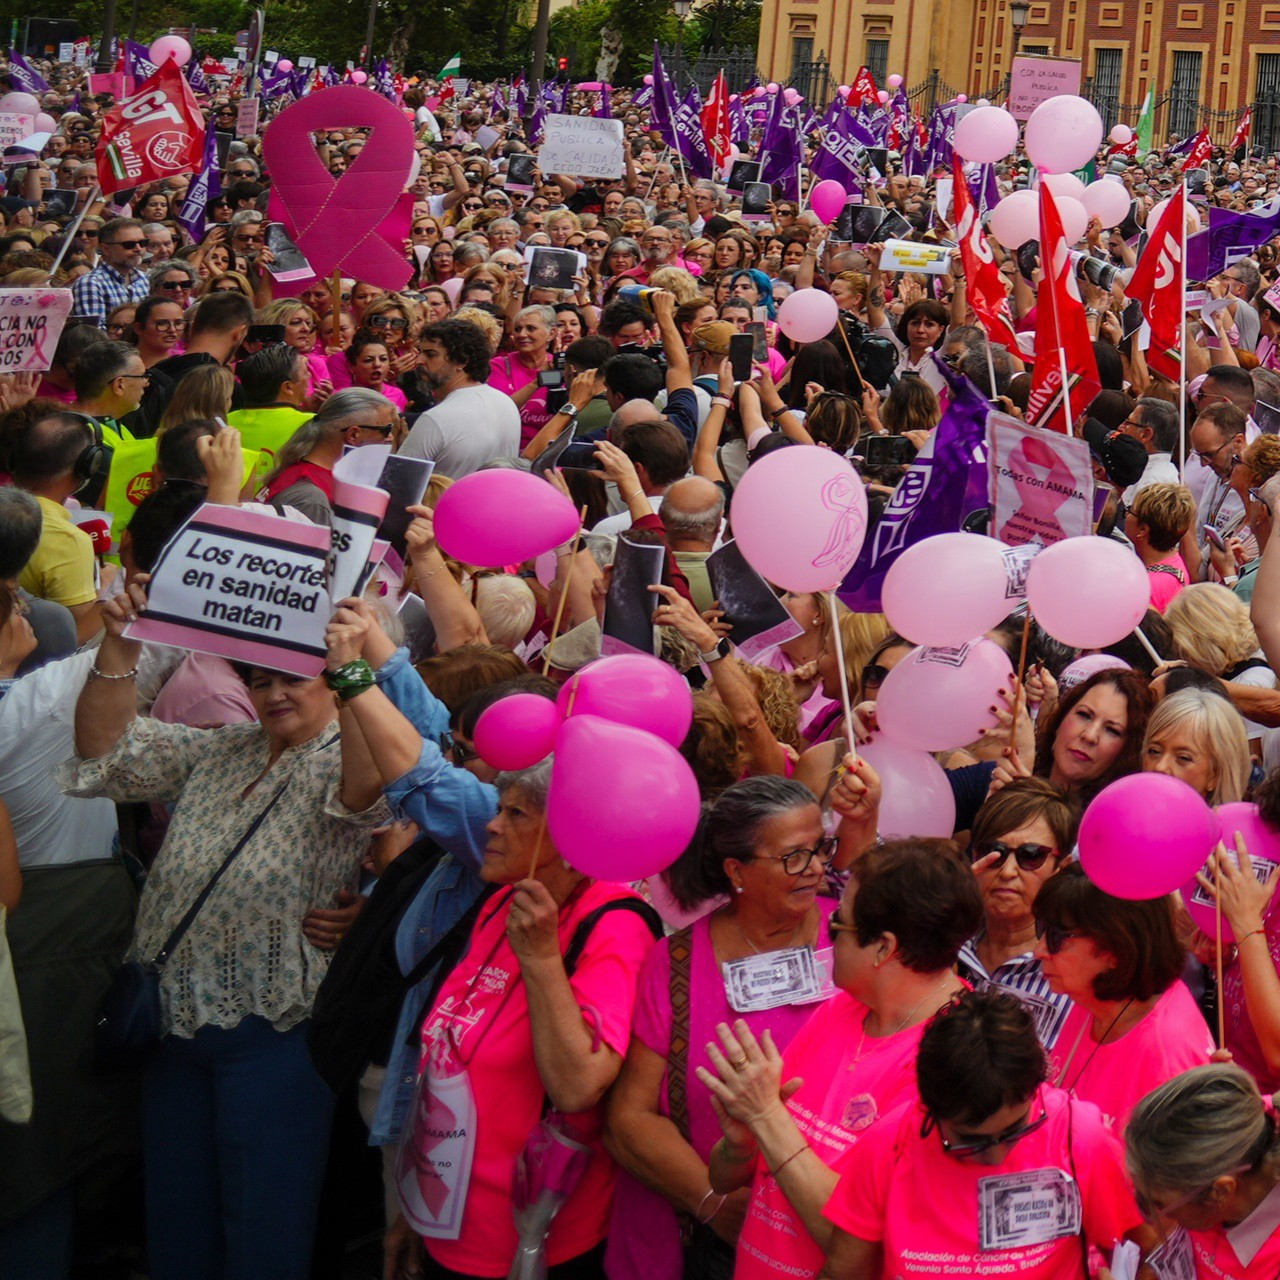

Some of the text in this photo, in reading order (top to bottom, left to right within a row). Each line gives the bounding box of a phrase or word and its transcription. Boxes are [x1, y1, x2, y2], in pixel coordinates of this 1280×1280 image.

[24, 315, 48, 331] NO
[5, 332, 37, 349] CON
[995, 465, 1024, 483] Todas
[1025, 476, 1044, 488] con
[185, 537, 234, 566] Los
[181, 568, 321, 613] en sanidad
[202, 600, 283, 632] matan
[424, 1127, 467, 1139] MAMA
[900, 1248, 955, 1263] Asociación
[957, 1253, 971, 1263] de
[943, 1263, 972, 1274] Santa
